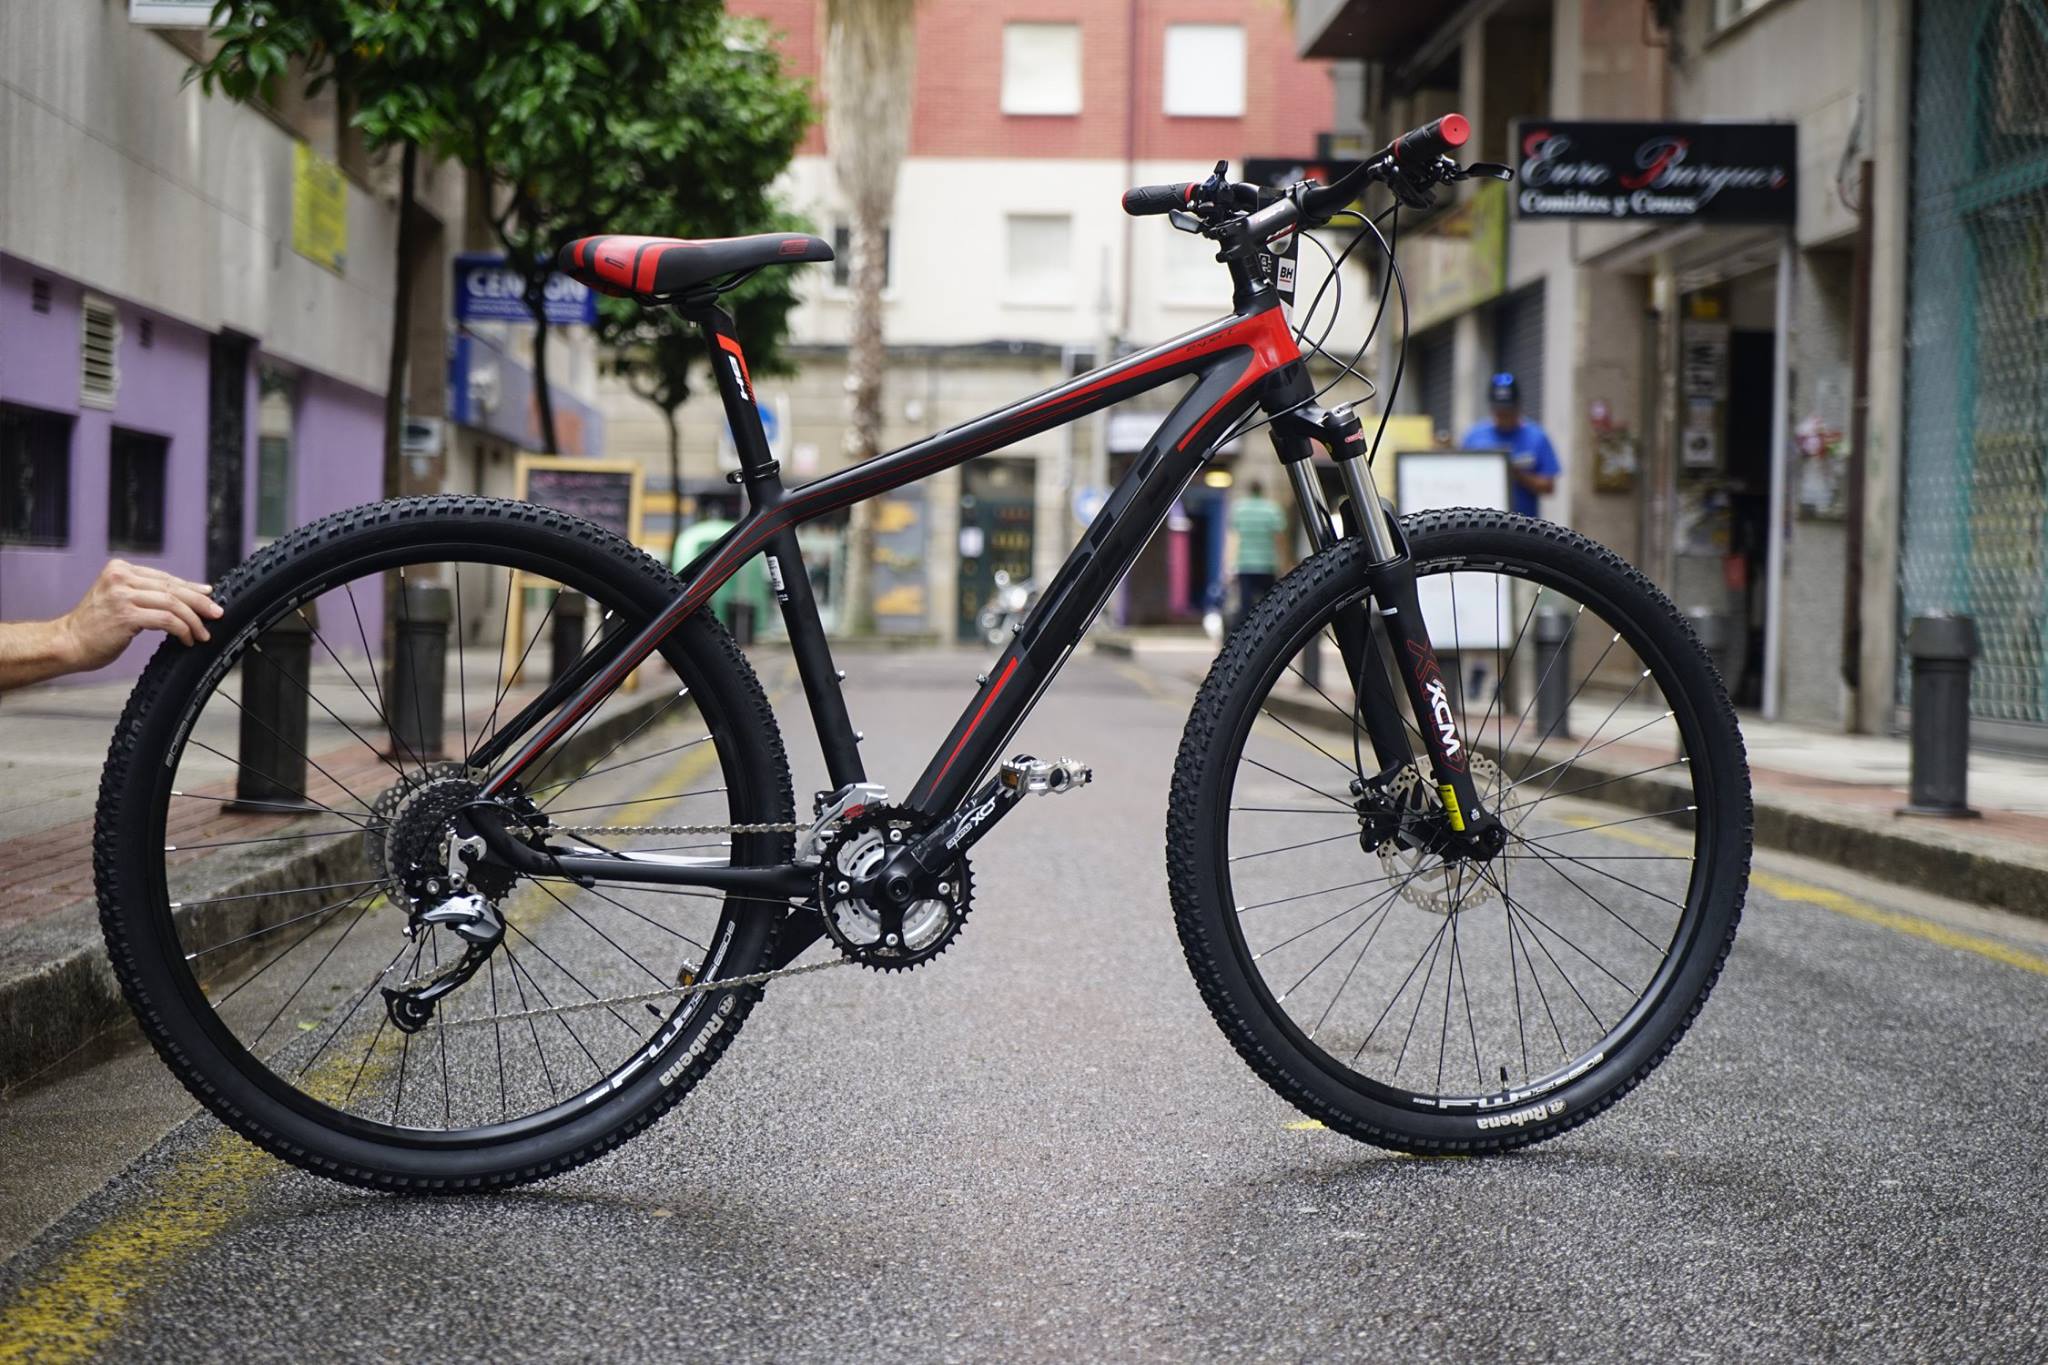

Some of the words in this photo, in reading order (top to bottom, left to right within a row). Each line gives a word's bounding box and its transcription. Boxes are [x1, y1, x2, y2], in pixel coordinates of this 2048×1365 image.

[1279, 266, 1294, 280] BH
[1426, 679, 1461, 757] XCM
[659, 1012, 725, 1087] Rubena
[1476, 1106, 1549, 1130] Rubena
